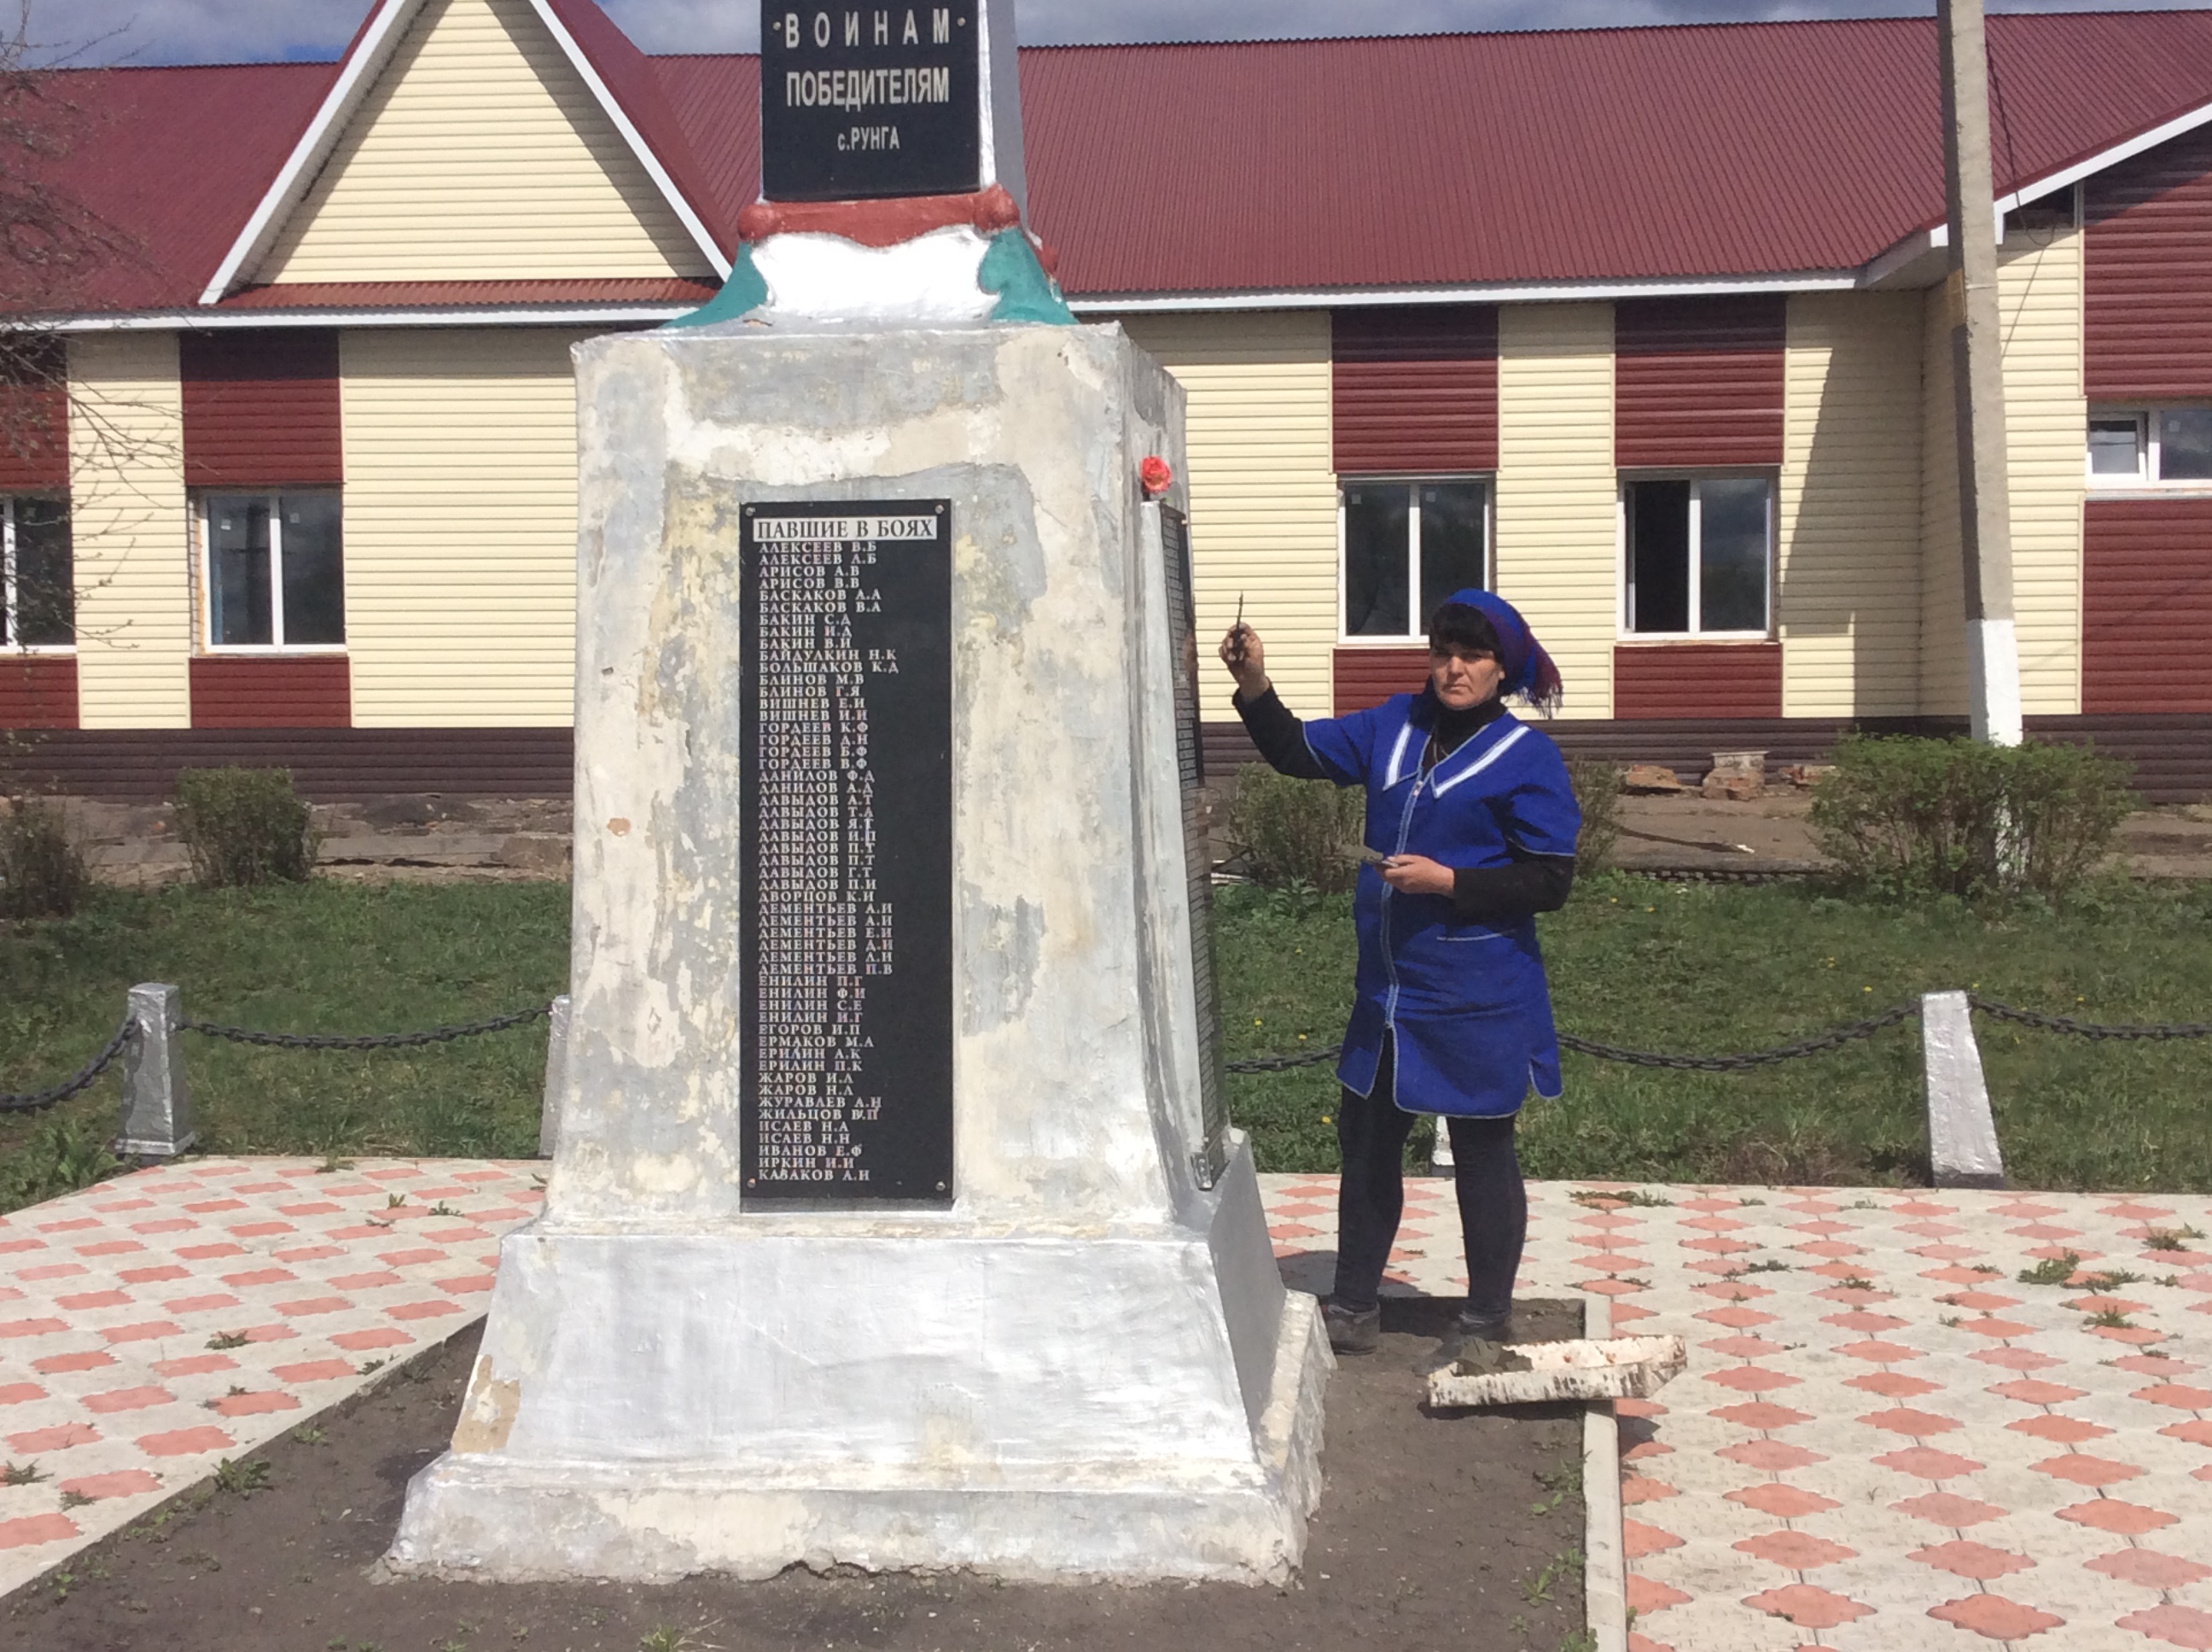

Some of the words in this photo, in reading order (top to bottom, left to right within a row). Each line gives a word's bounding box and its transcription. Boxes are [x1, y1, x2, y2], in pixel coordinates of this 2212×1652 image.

[785, 8, 951, 49] ВОИНАМ
[786, 67, 950, 113] ПОБЕДИТЕЛЯМ
[837, 125, 901, 151] с.РУНГА
[758, 520, 848, 539] ПАВШИЕ
[857, 520, 869, 539] В
[877, 520, 933, 539] БОЯХ
[760, 542, 843, 554] АЛЕКСЕЕВ
[851, 541, 877, 553] В.Б
[760, 553, 843, 565] АЛЕКСЕЕВ
[759, 565, 826, 577] АРИСОВ
[834, 564, 860, 577] А.В
[759, 577, 826, 589] АРИСОВ
[834, 577, 859, 589] В.В
[760, 589, 847, 601] БАСКАКОВ
[854, 588, 882, 601] А.А
[760, 601, 847, 614] БАСКАКОВ
[855, 601, 882, 613] В.А
[760, 614, 815, 625] БАКИН
[824, 613, 852, 626] С.Д
[760, 625, 816, 637] БАКИН
[759, 637, 815, 649] БАКИН
[824, 637, 851, 649] В.И
[759, 649, 859, 663] БАЙДУЛКИН
[868, 648, 897, 660] Н.К
[759, 661, 863, 673] БОЛЬШАКОВ
[871, 660, 899, 675] К.Д
[759, 673, 828, 685] БЛИНОВ
[835, 672, 864, 684] М.В
[759, 685, 827, 697] БЛИНОВ
[835, 684, 860, 697] Г.Я
[759, 697, 830, 709] ВИШНЕВ
[838, 696, 865, 709] Е.И
[759, 709, 830, 721] ВИШНЕВ
[759, 721, 832, 735] ГОРДЕЕВ
[841, 721, 869, 733] К.Ф
[759, 733, 832, 747] ГОРДЕЕВ
[759, 746, 832, 759] ГОРДЕЕВ
[840, 745, 868, 757] Б.Ф
[759, 758, 832, 771] ГОРДЕЕВ
[840, 757, 868, 770] В.Ф
[759, 770, 838, 783] ДАНИЛОВ
[847, 769, 876, 783] Ф.Д
[759, 782, 838, 795] ДАНИЛОВ
[846, 782, 873, 795] А.Д
[759, 794, 839, 807] ДАВЫДОВ
[847, 794, 873, 806] А.Т
[758, 806, 839, 819] ДАВЫДОВ
[758, 817, 840, 831] ДАВЫДОВ
[847, 817, 874, 829] Я.Т
[759, 829, 839, 844] ДАВЫДОВ
[758, 842, 839, 856] ДАВЫДОВ
[847, 841, 875, 853] П.Т
[758, 854, 839, 868] ДАВЫДОВ
[847, 853, 875, 866] П.Т
[759, 866, 839, 880] ДАВЫДОВ
[847, 866, 872, 878] Г.Т
[758, 878, 839, 892] ДАВЫДОВ
[847, 878, 877, 890] П.И
[758, 890, 838, 904] ДВОРЦОВ
[846, 890, 874, 902] К.И
[758, 902, 858, 916] ДЕМЕНТЬЕВ
[864, 902, 893, 914] А.И
[758, 914, 858, 928] ДЕМЕНТЬЕВ
[864, 914, 893, 926] А.И
[758, 927, 857, 940] ДЕМЕНТЬЕВ
[864, 926, 892, 939] Е.И
[758, 939, 857, 952] ДЕМЕНТЬЕВ
[865, 939, 894, 952] Д.И
[758, 951, 857, 964] ДЕМЕНТЬЕВ
[758, 963, 857, 976] ДЕМЕНТЬЕВ
[865, 963, 893, 975] П.В
[758, 974, 828, 986] ЕНИЛИН
[836, 974, 862, 986] П.Г
[759, 986, 828, 998] ЕНИЛИН
[836, 986, 865, 999] Ф.И
[759, 998, 828, 1011] ЕНИЛИН
[836, 998, 863, 1011] С.Е
[758, 1011, 828, 1023] ЕНИЛИН
[836, 1011, 862, 1023] И.Г
[758, 1023, 823, 1035] ЕГОРОВ
[831, 1023, 860, 1035] И.П
[759, 1035, 836, 1047] ЕРМАКОВ
[845, 1035, 875, 1048] М.А
[758, 1047, 826, 1059] ЕРИЛИН
[834, 1047, 861, 1060] А.К
[758, 1059, 825, 1071] ЕРИЛИН
[834, 1060, 863, 1072] П.К
[758, 1071, 817, 1084] ЖАРОВ
[758, 1084, 818, 1096] ЖАРОВ
[758, 1096, 846, 1108] ЖУРАВЛЕВ
[758, 1108, 842, 1121] ЖИЛЬЦОВ
[759, 1120, 812, 1131] ИСАЕВ
[821, 1120, 849, 1132] Н.А
[759, 1131, 812, 1144] ИСАЕВ
[821, 1132, 850, 1144] Н.Н
[758, 1144, 827, 1156] ИВАНОВ
[835, 1144, 862, 1157] Е.Ф
[758, 1156, 816, 1168] ИРКИН
[825, 1156, 854, 1169] И.И
